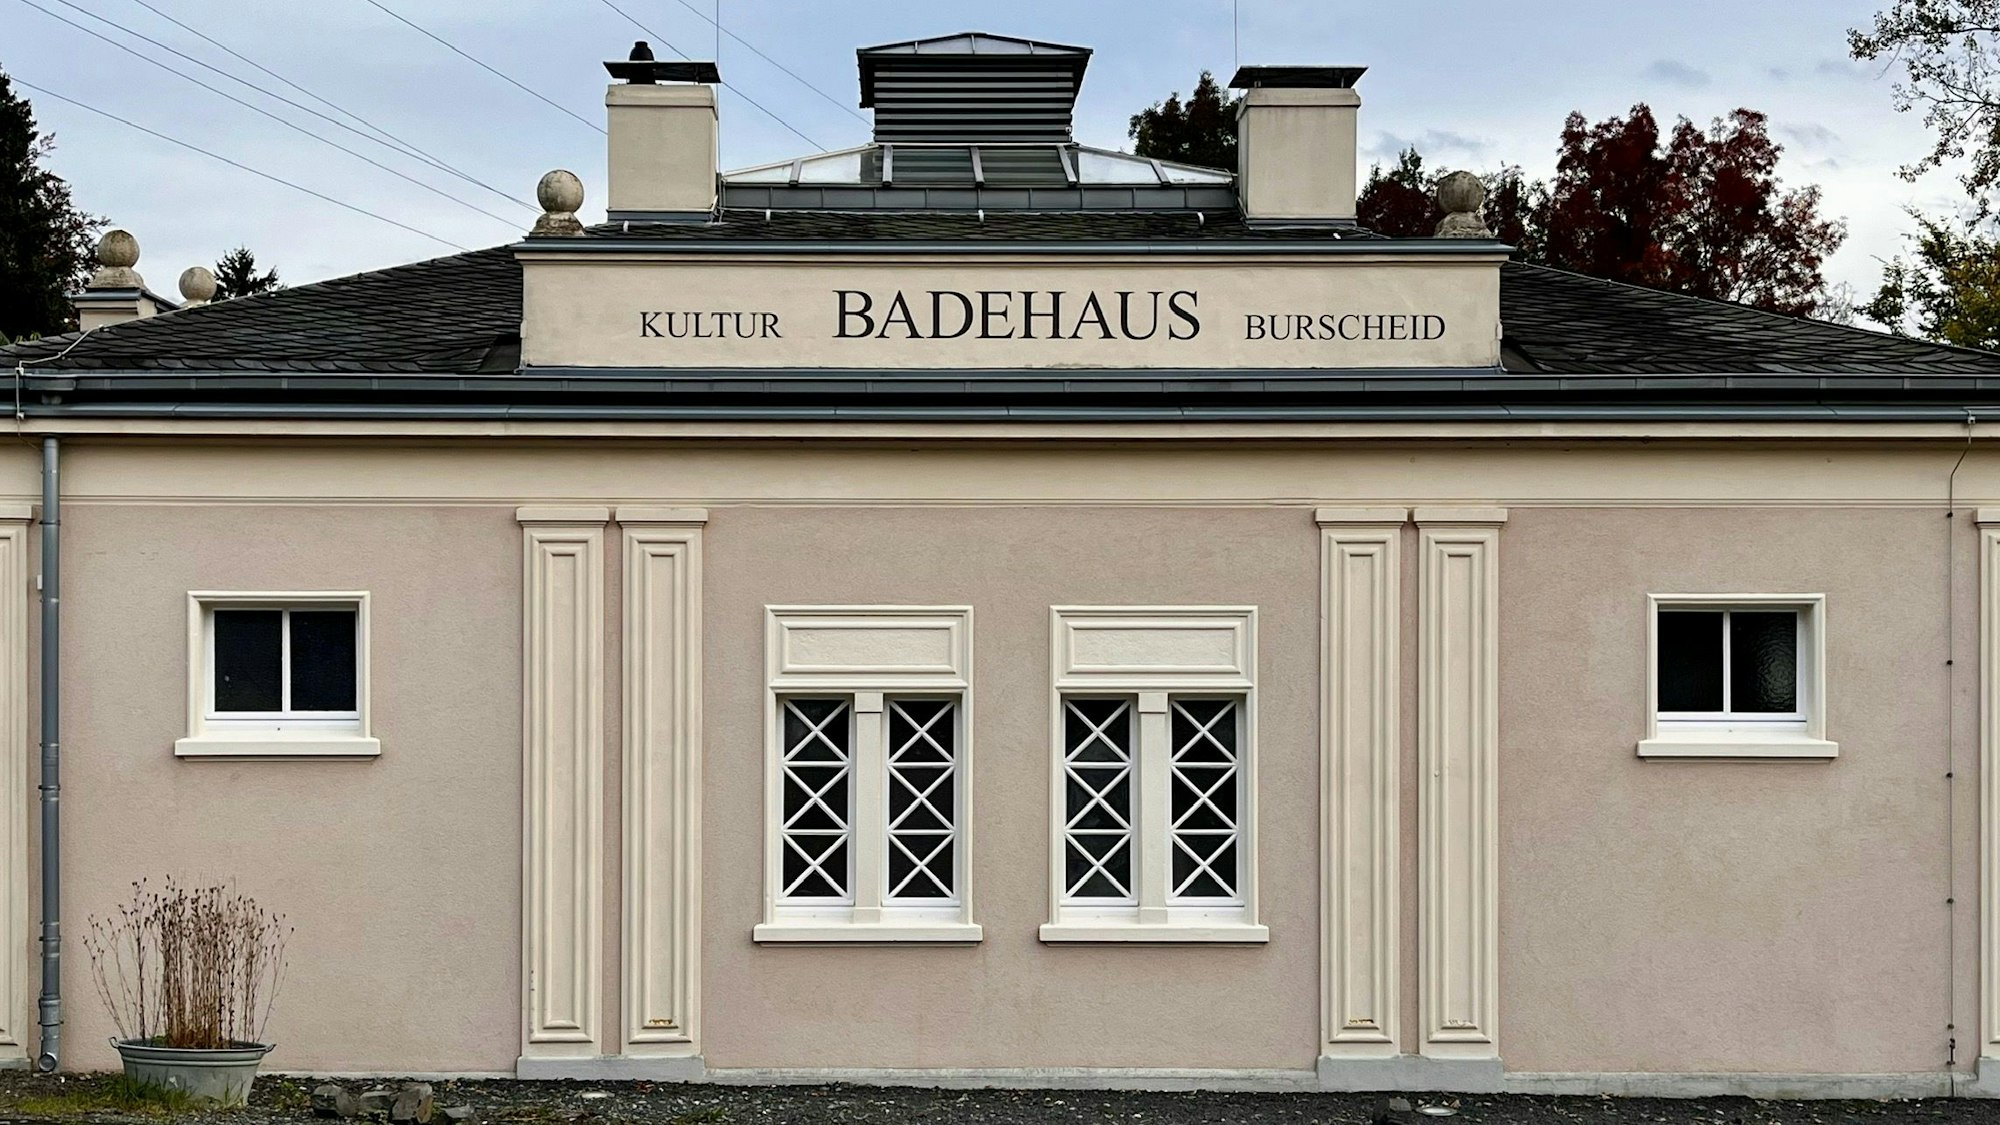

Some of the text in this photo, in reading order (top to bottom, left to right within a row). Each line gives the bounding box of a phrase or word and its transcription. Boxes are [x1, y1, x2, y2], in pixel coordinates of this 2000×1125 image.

[640, 289, 1446, 341] KULTUR BADEHAUS BURSCHEID
